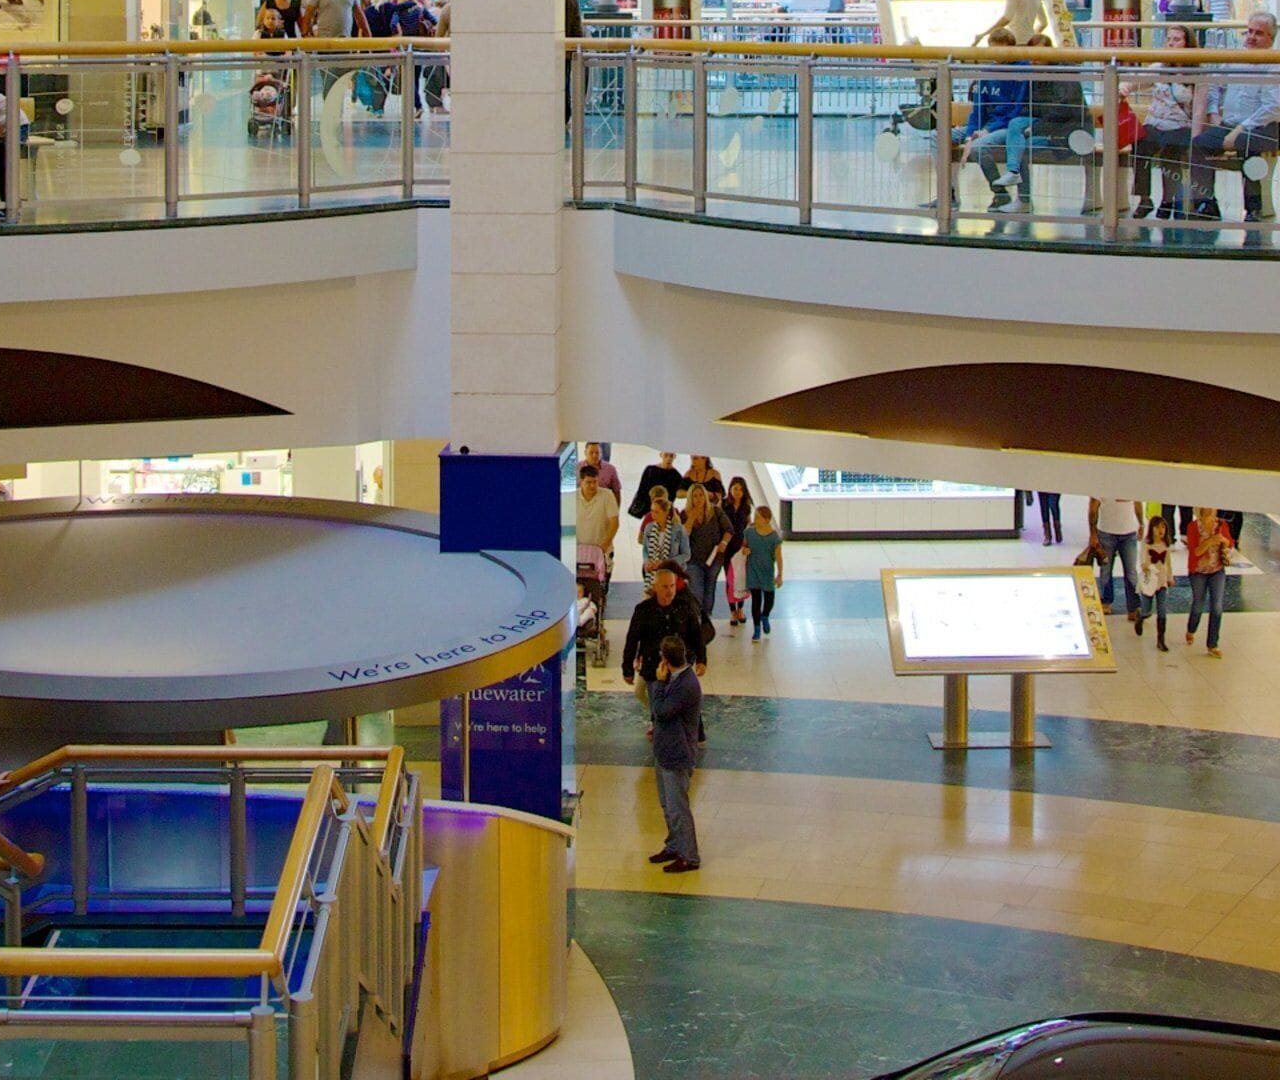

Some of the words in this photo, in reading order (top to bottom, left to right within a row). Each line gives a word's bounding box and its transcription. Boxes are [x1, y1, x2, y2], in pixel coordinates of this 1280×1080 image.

[328, 661, 410, 683] We're
[415, 643, 476, 665] here
[480, 633, 507, 645] to
[501, 608, 551, 635] help
[454, 722, 485, 733] W're
[486, 722, 510, 734] here
[511, 724, 524, 733] to
[524, 722, 548, 735] help
